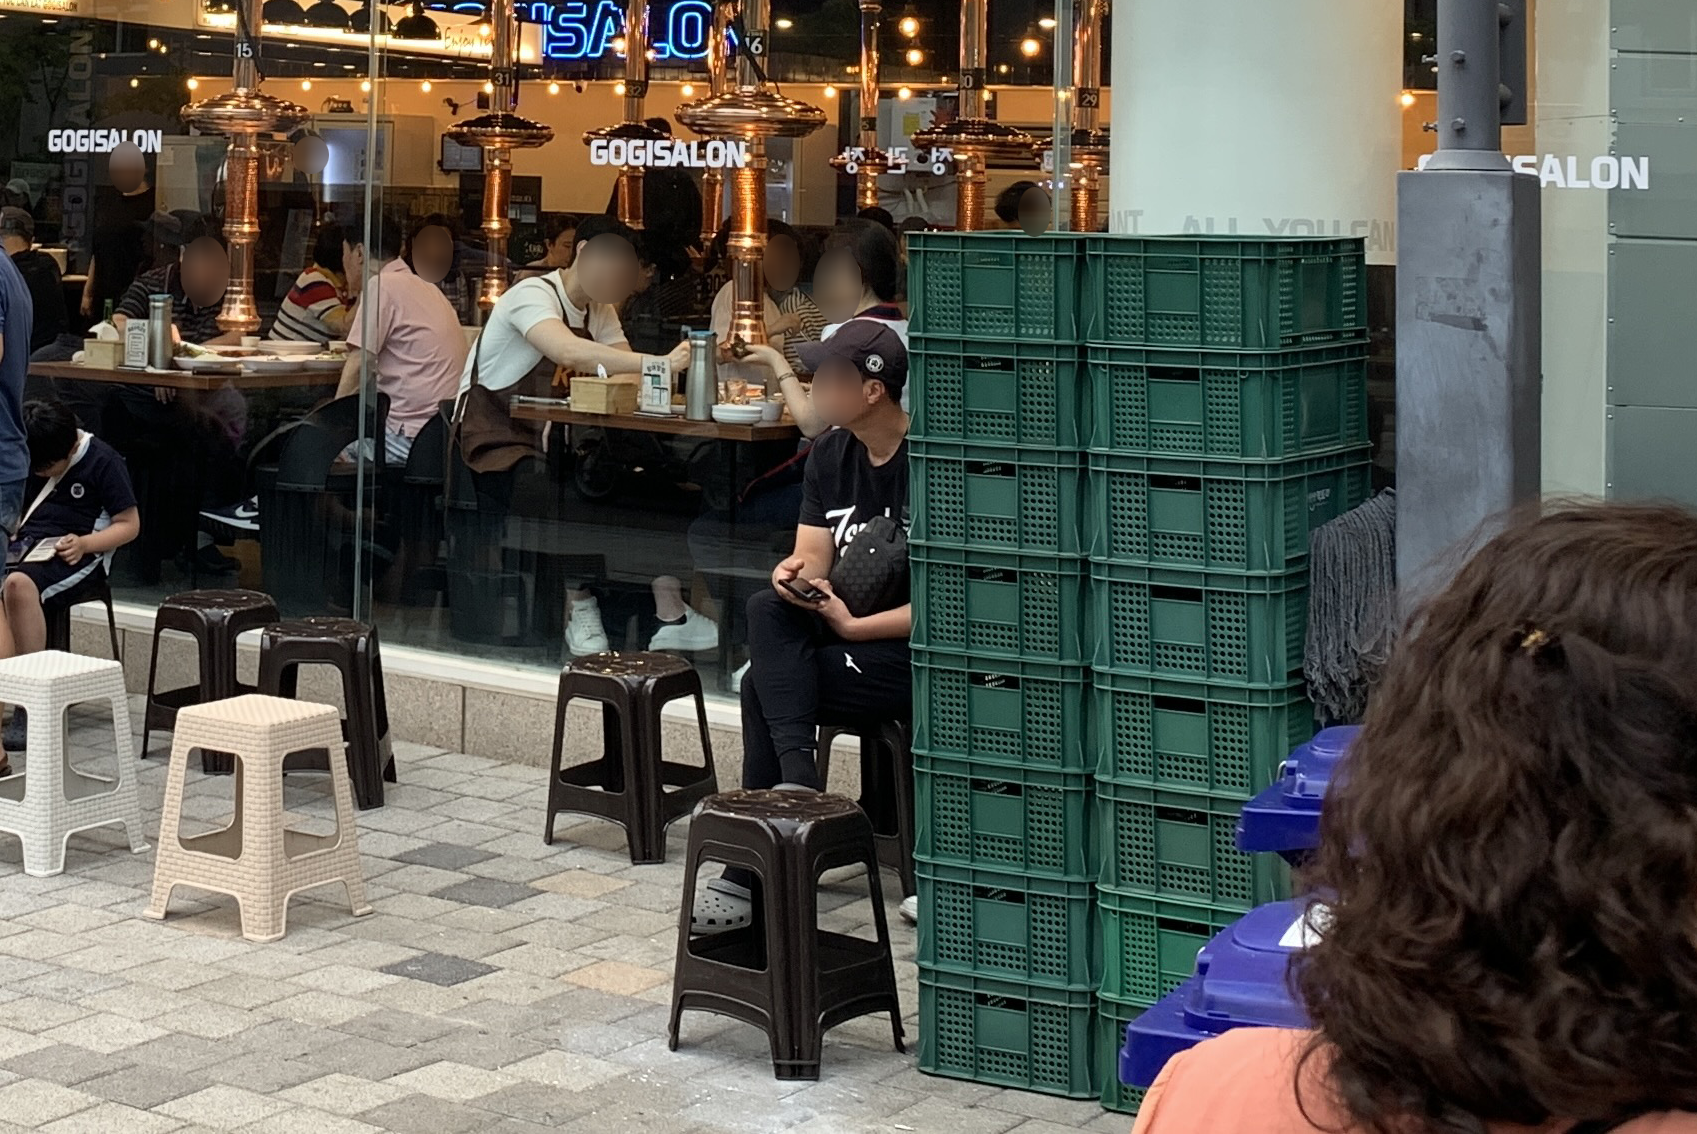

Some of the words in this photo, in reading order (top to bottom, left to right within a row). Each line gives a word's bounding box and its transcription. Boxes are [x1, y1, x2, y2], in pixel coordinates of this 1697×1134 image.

[235, 42, 253, 59] 15
[495, 72, 510, 86] 31
[1081, 93, 1098, 107] 29
[48, 128, 162, 154] GOGISALON
[590, 139, 748, 168] GOGISALON
[1417, 153, 1650, 190] SALON
